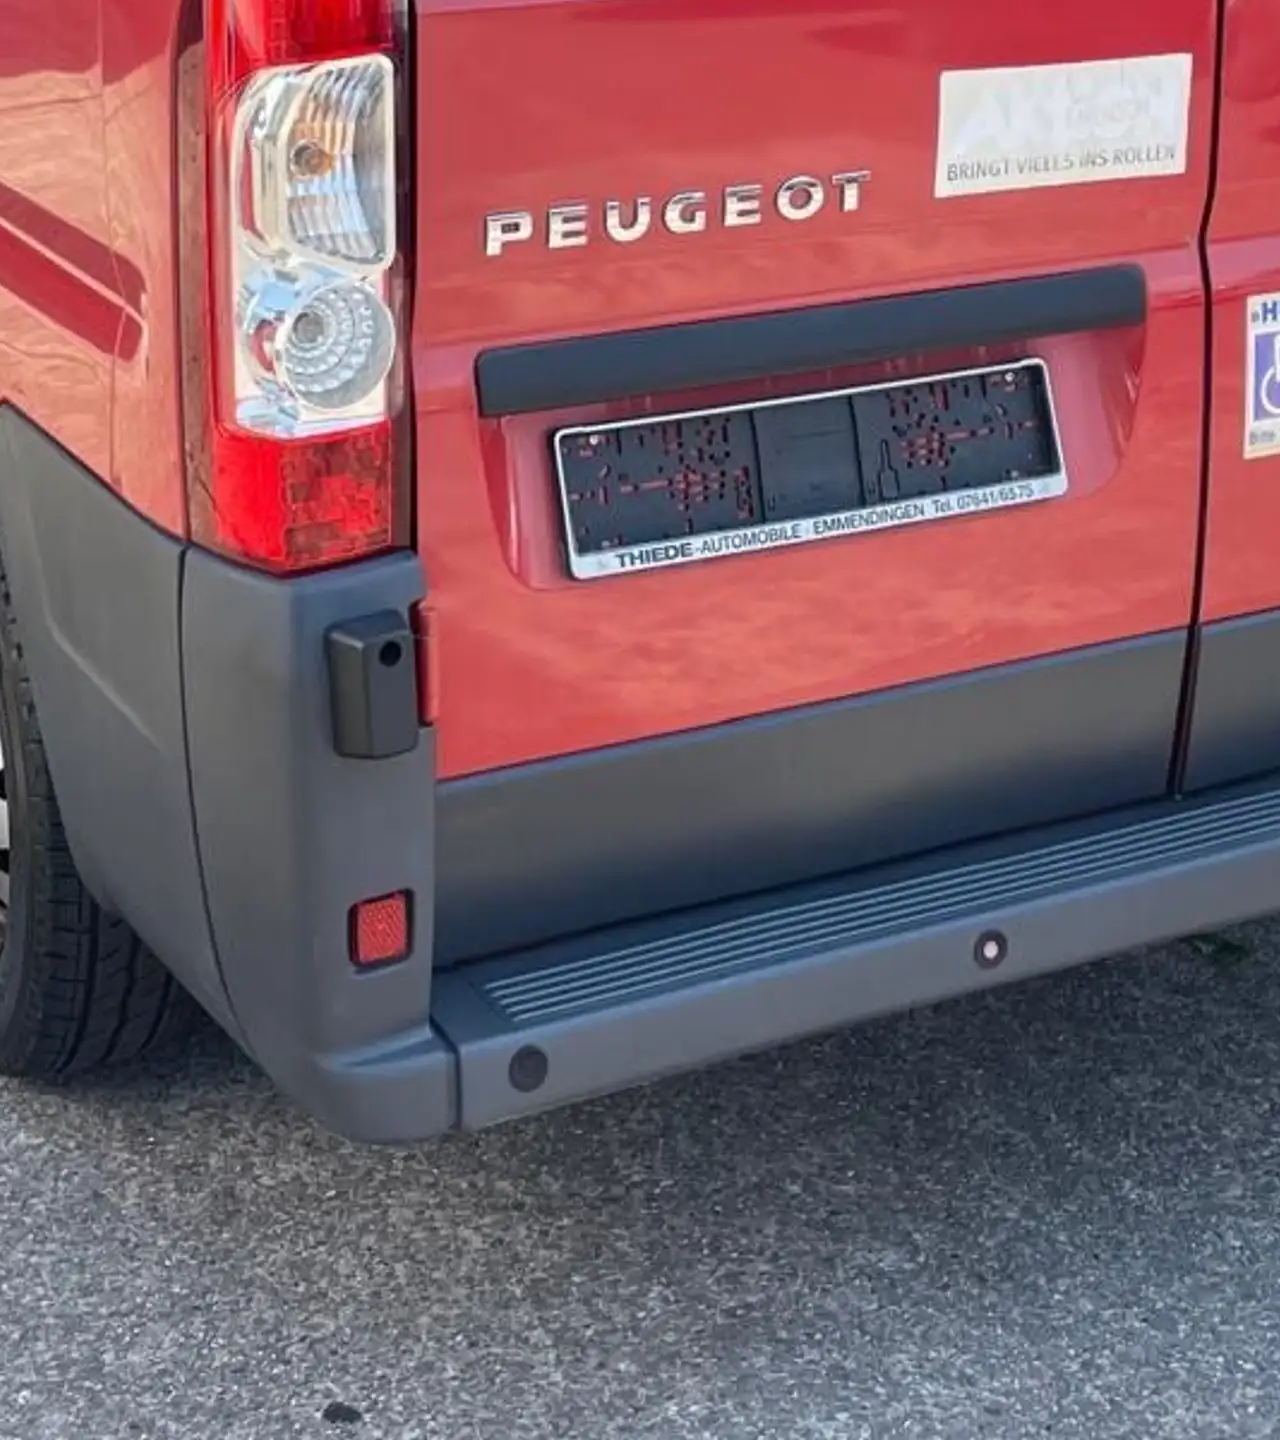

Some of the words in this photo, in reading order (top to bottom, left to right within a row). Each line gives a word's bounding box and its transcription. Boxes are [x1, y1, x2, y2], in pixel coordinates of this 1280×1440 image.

[947, 159, 1010, 181] BRINGT
[484, 170, 871, 256] PEUGEOT
[813, 502, 925, 535] EMMENDINGEN
